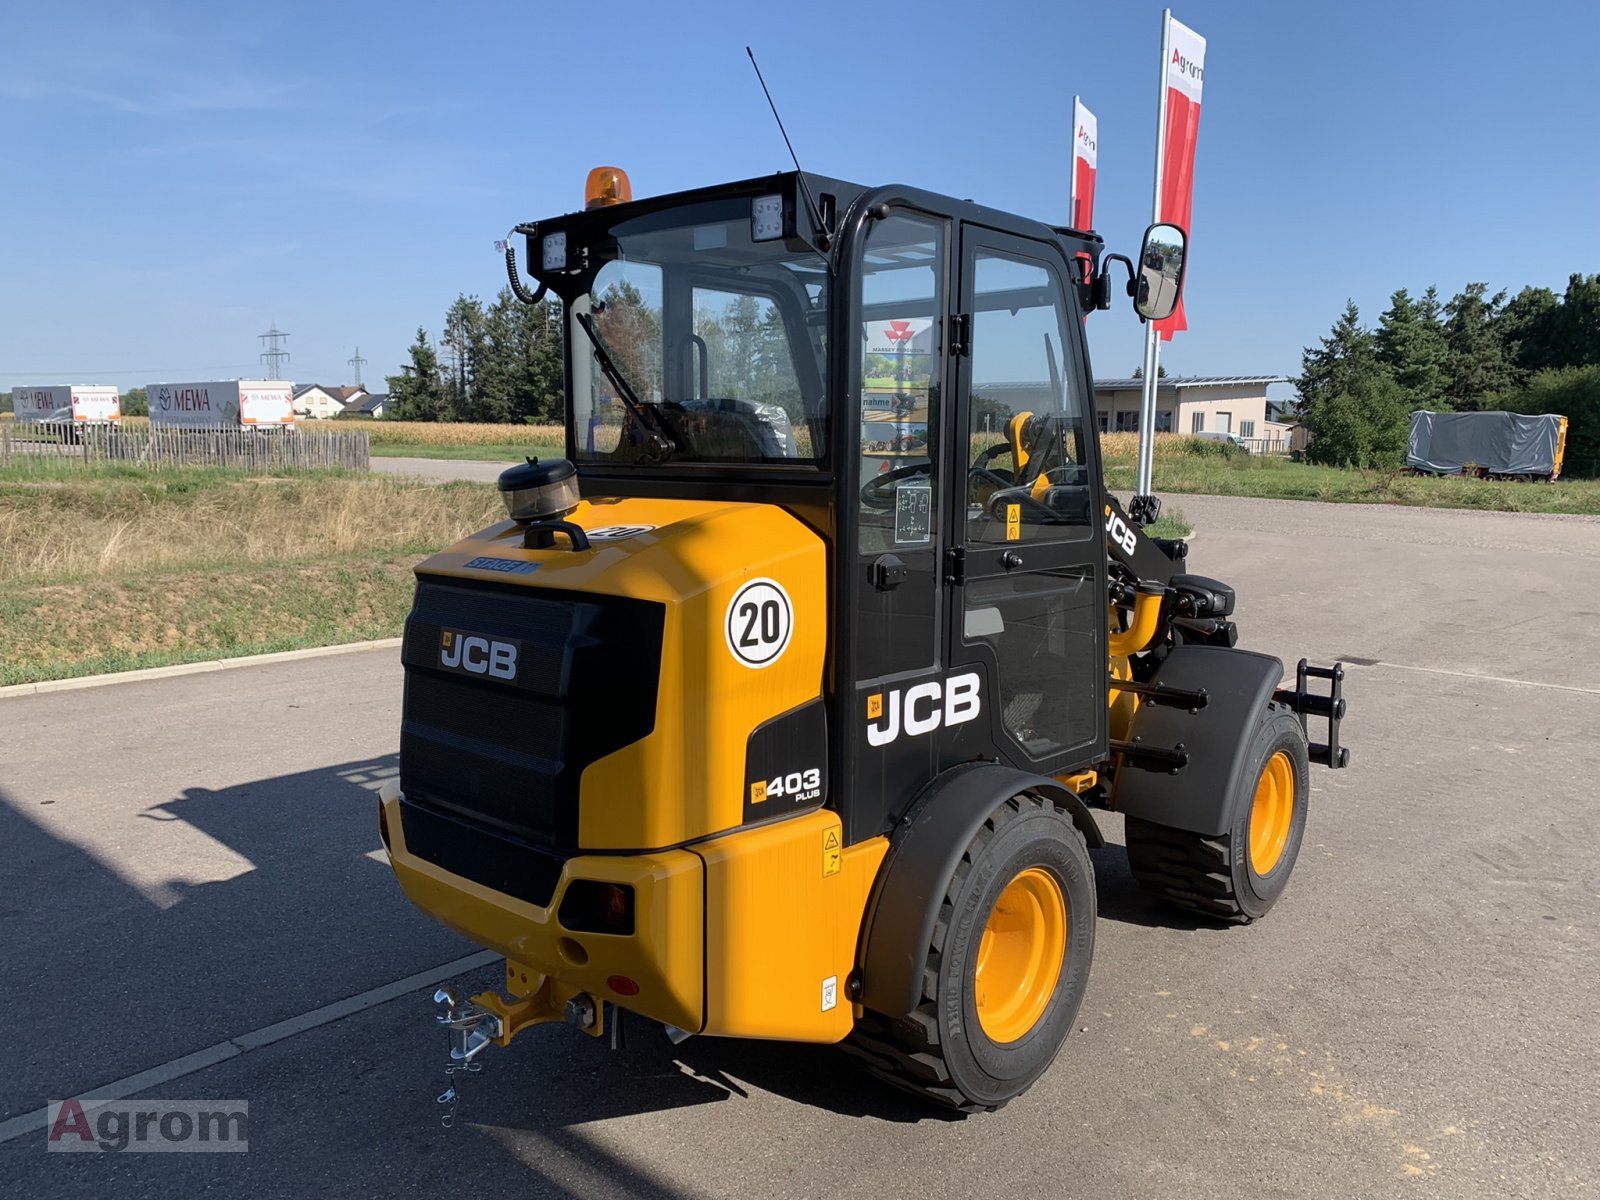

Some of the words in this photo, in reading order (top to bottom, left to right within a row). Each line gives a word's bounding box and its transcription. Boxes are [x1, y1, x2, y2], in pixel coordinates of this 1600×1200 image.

[30, 391, 54, 410] MEWA
[174, 389, 210, 411] MEWA
[587, 526, 646, 537] 20
[1105, 511, 1137, 556] JCB
[468, 558, 519, 571] STAGE
[739, 599, 780, 648] 20
[441, 633, 517, 680] JCB
[867, 672, 981, 747] JCB
[767, 768, 821, 797] 403
[795, 789, 820, 802] PLUS
